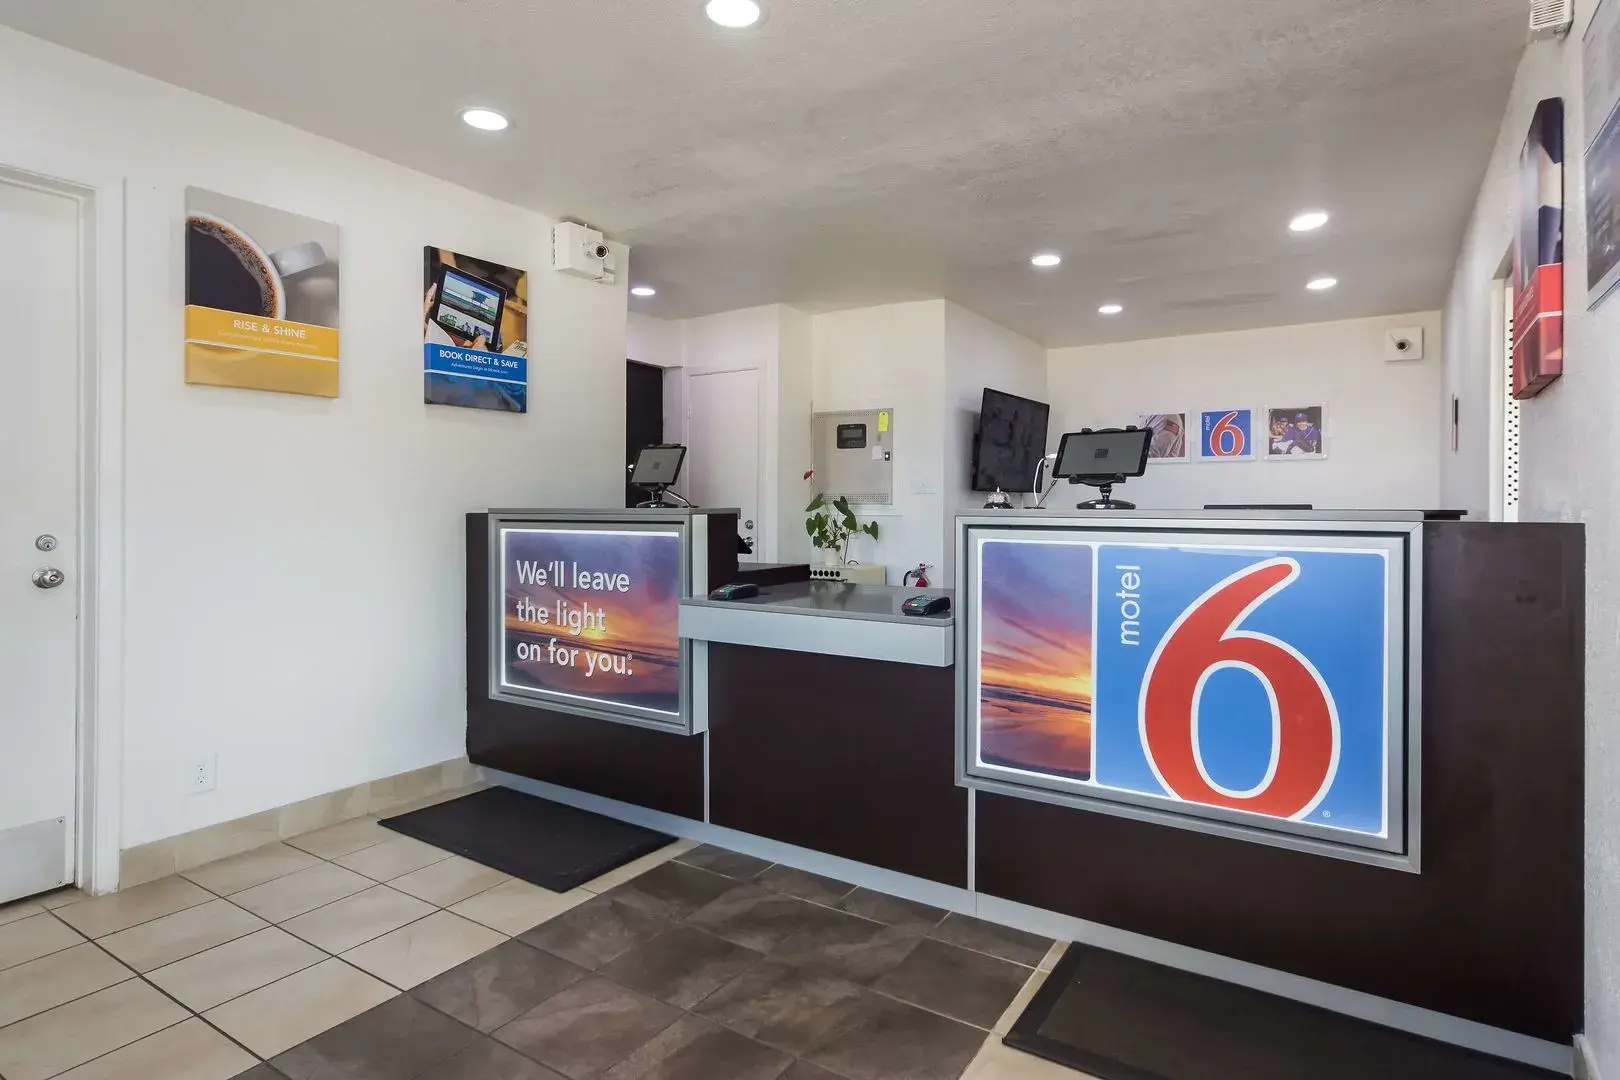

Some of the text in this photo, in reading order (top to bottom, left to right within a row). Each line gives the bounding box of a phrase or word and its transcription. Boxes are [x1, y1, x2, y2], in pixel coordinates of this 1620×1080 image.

[233, 319, 307, 339] RISE & SHINE
[440, 349, 519, 369] BOOK DIRECT & SAVE
[1210, 411, 1245, 456] 6
[516, 559, 631, 593] We'll leave
[516, 597, 607, 637] the light
[516, 641, 541, 662] on
[548, 637, 579, 667] for
[1115, 556, 1342, 822] motel 6
